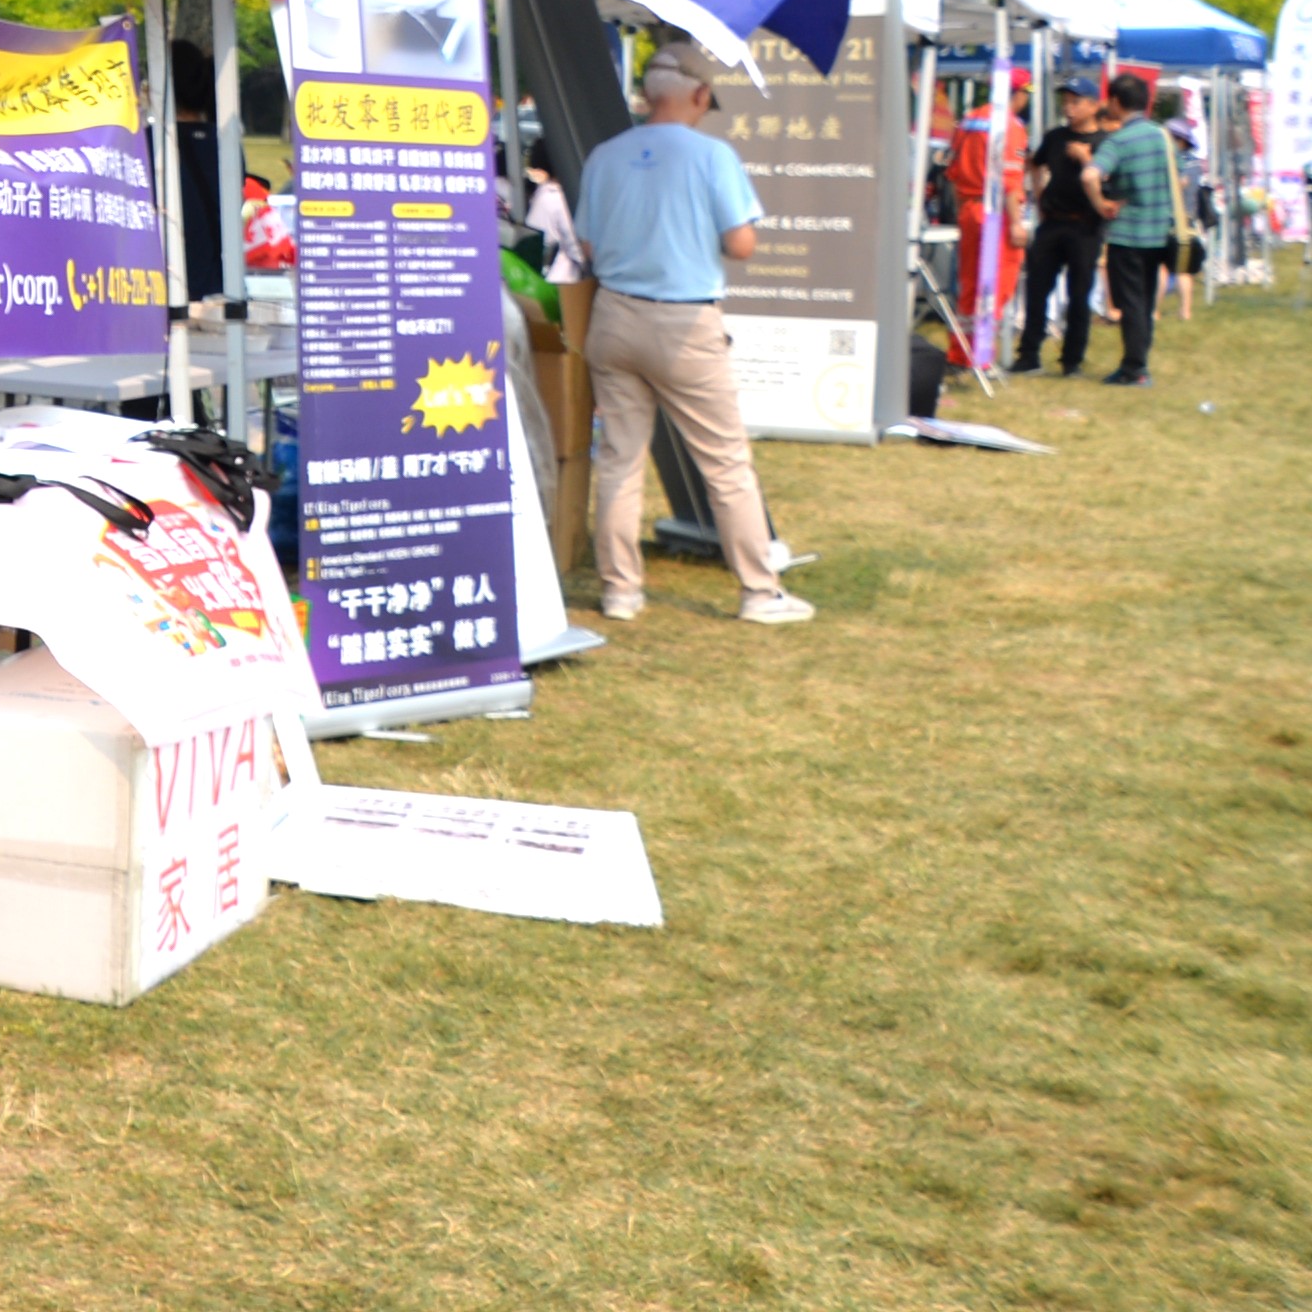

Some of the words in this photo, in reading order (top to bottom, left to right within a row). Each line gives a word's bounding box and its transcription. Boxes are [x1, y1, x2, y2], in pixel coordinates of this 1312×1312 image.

[845, 37, 876, 62] 21
[784, 162, 875, 178] COMMERCIAL
[794, 216, 853, 231] DELIVER
[152, 716, 258, 835] VIVA
[157, 823, 242, 954] 家居
